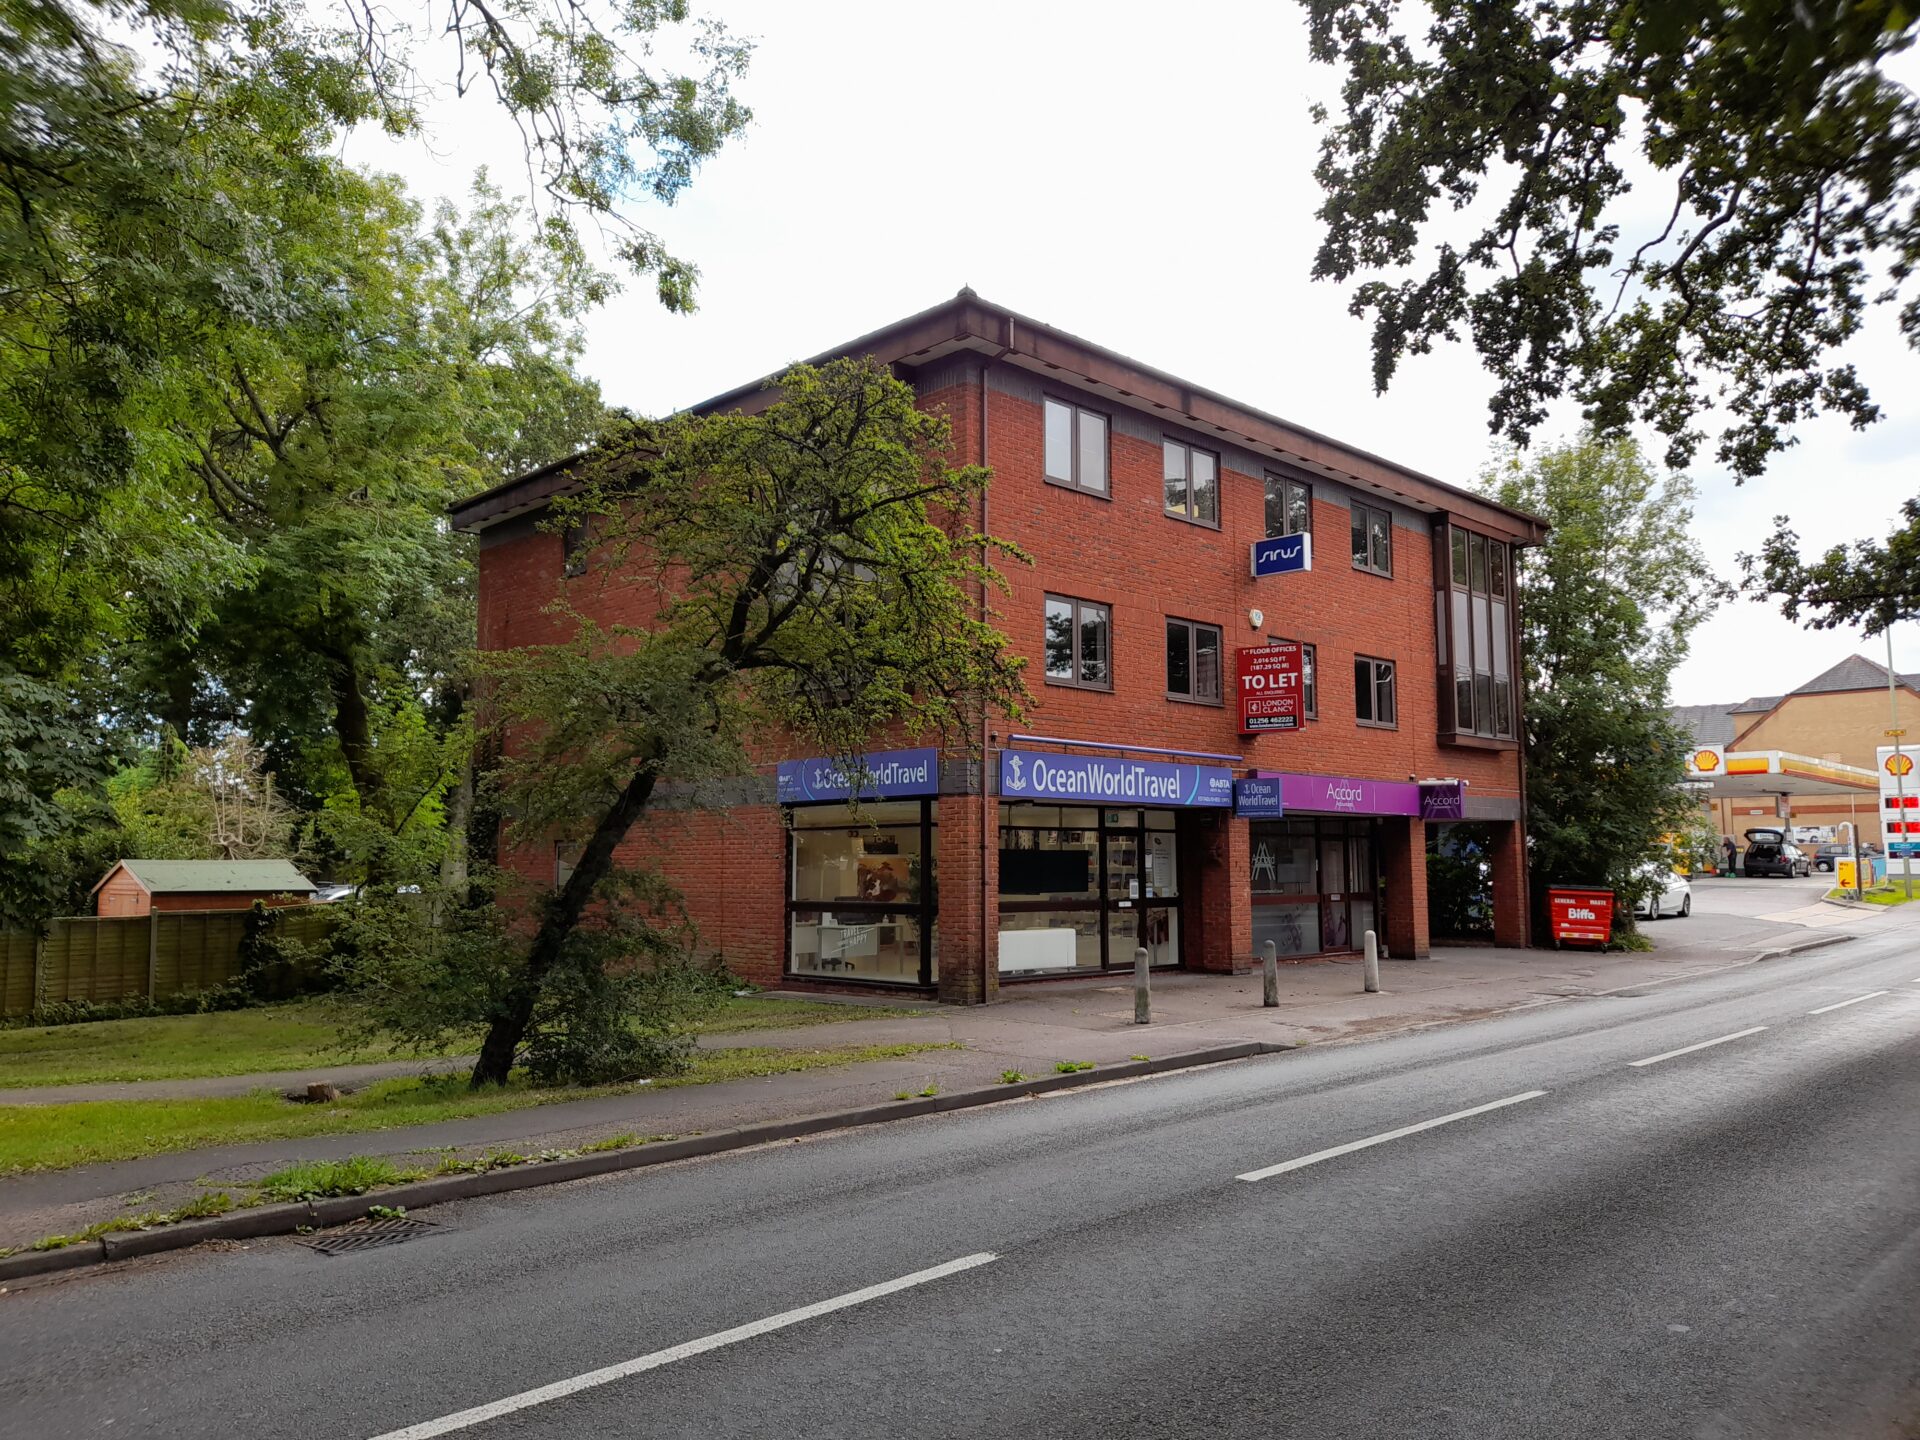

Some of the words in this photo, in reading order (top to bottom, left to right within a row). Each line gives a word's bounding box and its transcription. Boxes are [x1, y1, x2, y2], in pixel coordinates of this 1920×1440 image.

[1242, 675, 1265, 689] TO
[1269, 672, 1298, 688] LET
[1262, 699, 1294, 707] LONDON
[1032, 759, 1181, 799] OceanWorldTravel
[1250, 783, 1272, 794] Ocean
[1326, 782, 1362, 801] Accord
[1238, 794, 1278, 806] WorldTravel
[1423, 795, 1460, 805] Accord
[1567, 907, 1596, 920] Biffa
